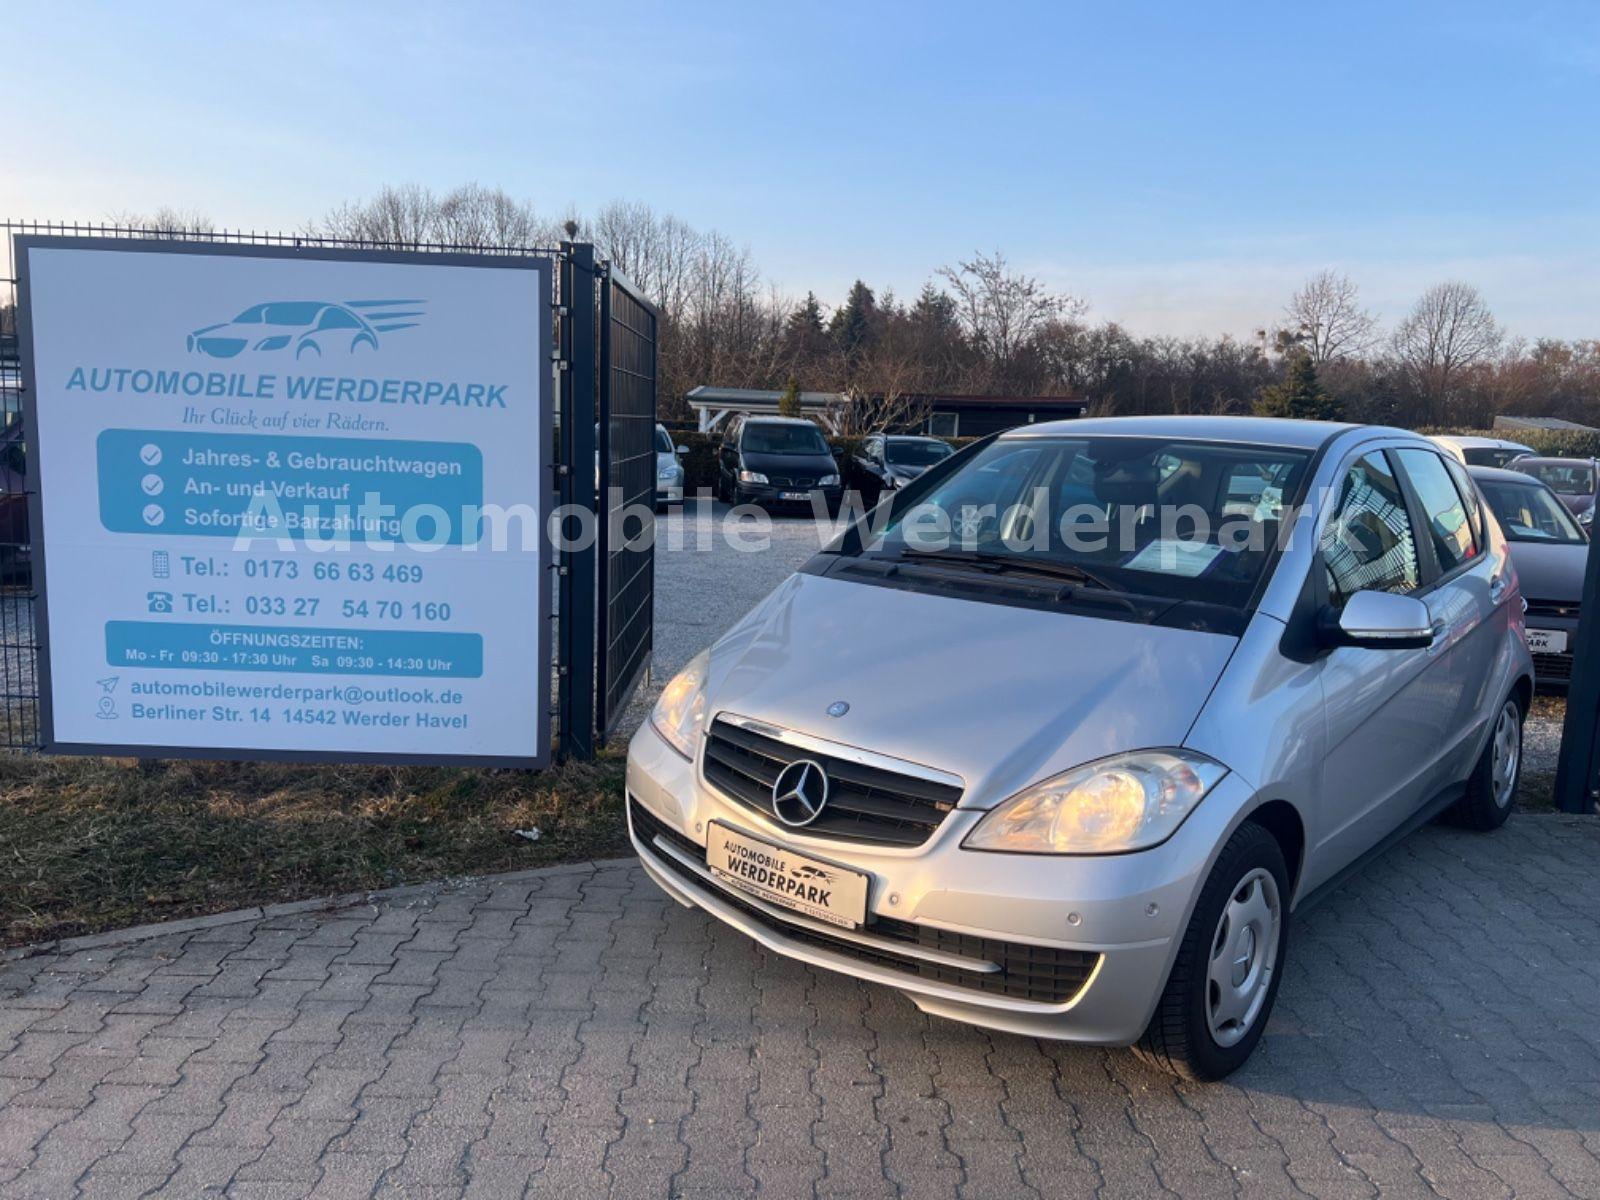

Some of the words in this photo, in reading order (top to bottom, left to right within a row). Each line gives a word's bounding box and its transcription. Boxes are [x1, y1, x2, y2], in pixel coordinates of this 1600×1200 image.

[65, 366, 277, 399] AUTOMOBILE
[286, 376, 508, 408] WERDERPARK
[182, 407, 205, 424] Ihr
[211, 407, 258, 428] Glück
[262, 411, 289, 430] auf
[292, 412, 320, 429] vier
[326, 412, 390, 431] Rädern.
[182, 448, 260, 467] Jahres-
[266, 451, 281, 468] &
[287, 452, 462, 478] Gebrauchtwagen
[184, 477, 220, 495] An-
[226, 480, 265, 496] und
[271, 481, 350, 500] Verkauf
[184, 508, 278, 532] Sofortige
[285, 511, 400, 536] Barzahlung
[180, 556, 228, 577] Tel.:
[244, 558, 299, 579] 0173
[314, 561, 340, 580] 66
[348, 562, 374, 582] 63
[382, 564, 423, 583] 469
[182, 593, 230, 614] Tel.:
[246, 595, 286, 615] 033
[293, 597, 320, 616] 27
[342, 600, 369, 618] 54
[376, 600, 403, 619] 70
[411, 602, 451, 621] 160
[209, 629, 364, 650] ÖFFNUNGSZEITEN:
[125, 649, 147, 661] Mo
[159, 649, 175, 662] Fr
[181, 650, 219, 663] 09:30
[232, 652, 268, 665] 17:30
[272, 654, 298, 666] Uhr
[311, 654, 330, 668] Sa
[337, 656, 374, 669] 09:30
[387, 658, 424, 670] 14:30
[427, 659, 453, 671] Uhr
[131, 680, 463, 706] automobilewerderpark@outlook.de
[132, 703, 206, 721] Berliner
[212, 706, 243, 722] Str.
[250, 708, 271, 723] 14
[283, 708, 336, 725] 14542
[342, 710, 410, 727] Werder
[416, 712, 468, 729] Havel
[724, 840, 786, 872] AUTOMOBILE
[727, 855, 832, 907] WERDERPARK
